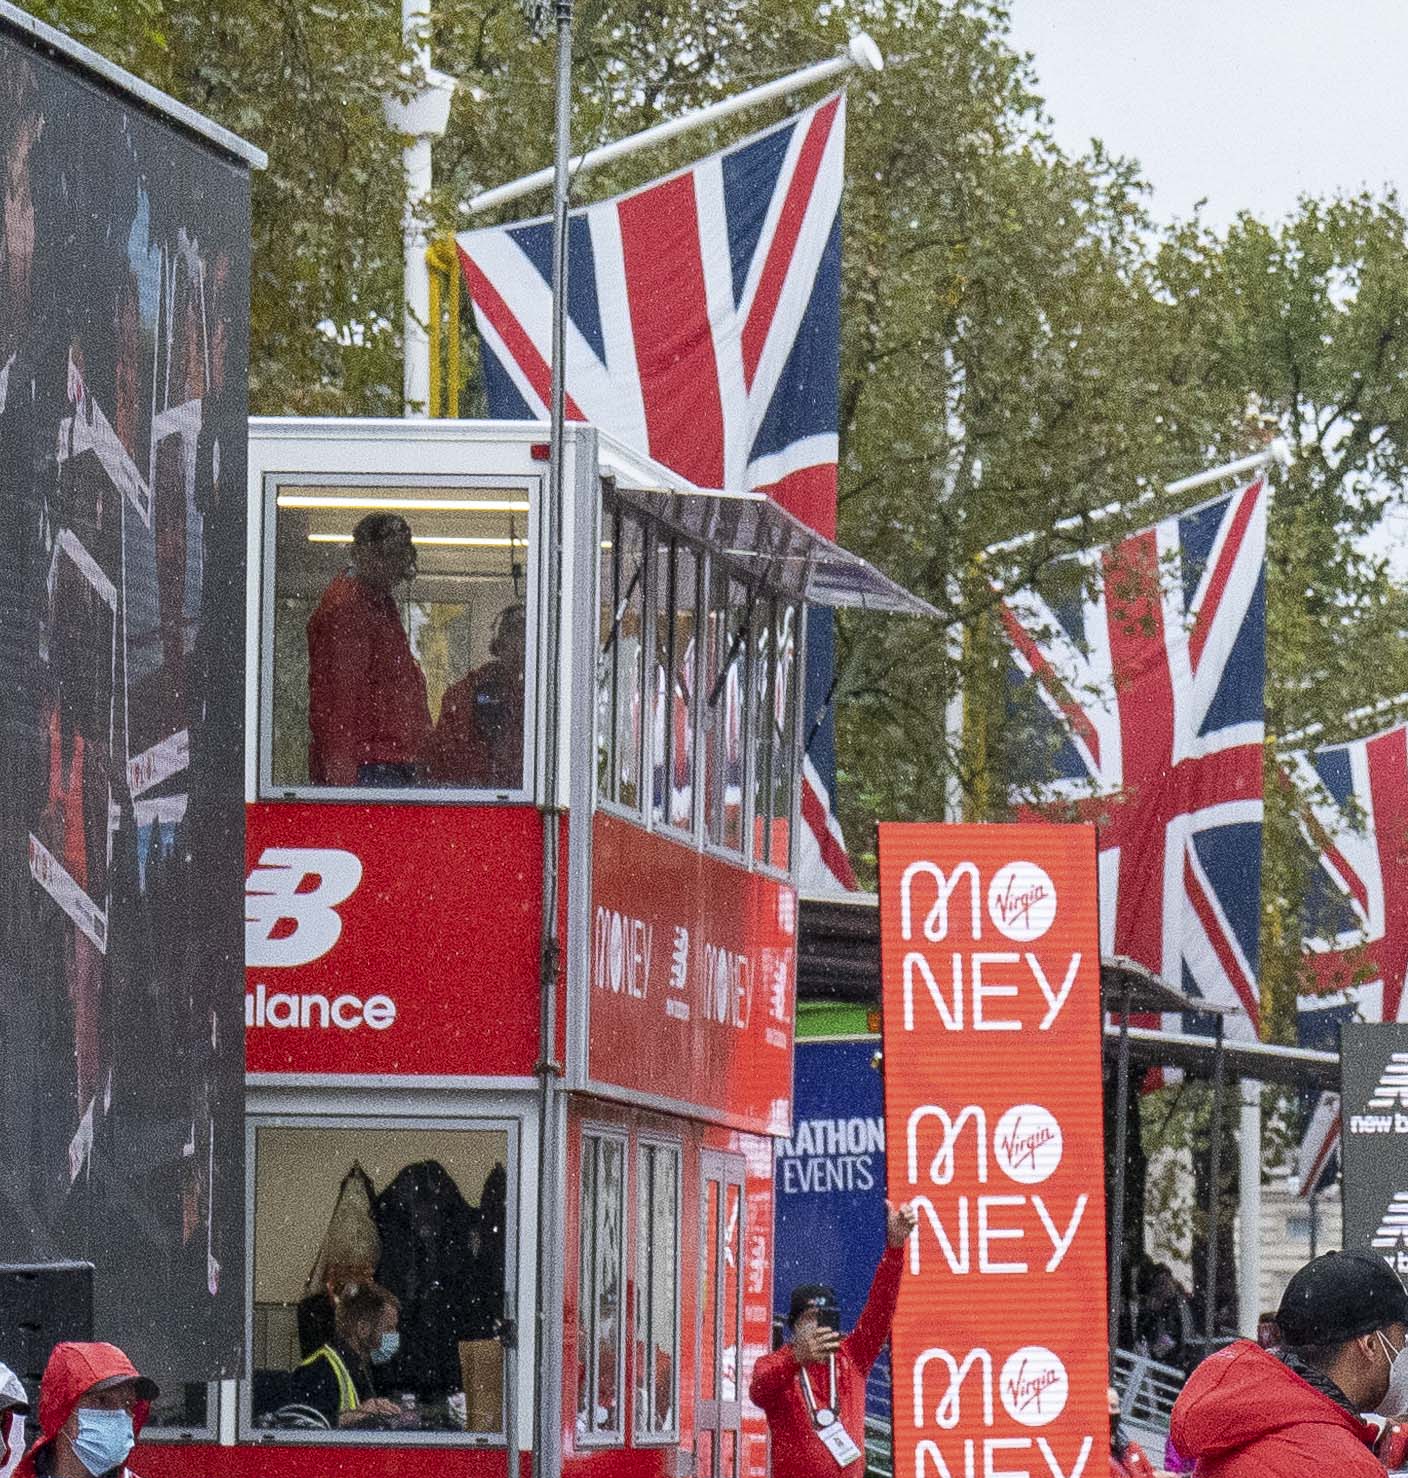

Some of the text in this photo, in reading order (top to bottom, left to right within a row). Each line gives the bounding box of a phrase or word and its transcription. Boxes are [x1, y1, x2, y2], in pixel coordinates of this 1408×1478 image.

[995, 874, 1048, 929] Virgin
[245, 984, 397, 1029] lance
[1001, 1116, 1056, 1170] Virgin
[1350, 1115, 1392, 1133] new
[783, 1157, 873, 1193] EVENTS
[1008, 1358, 1061, 1413] Virgin
